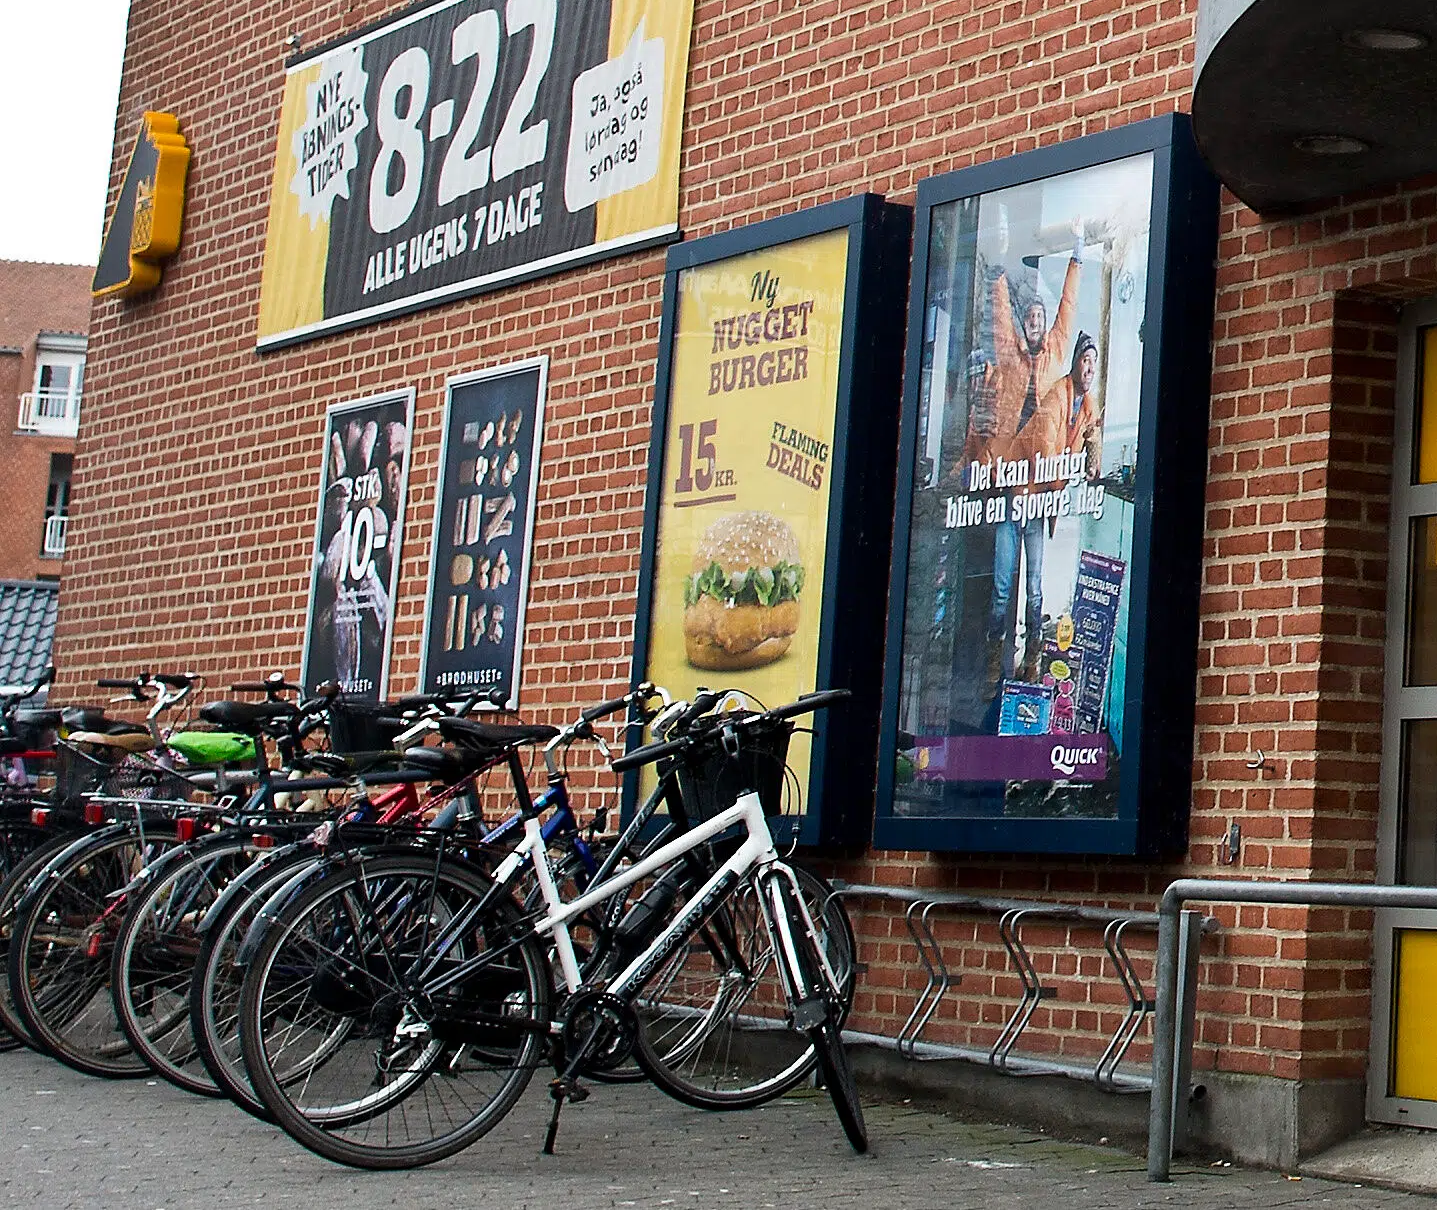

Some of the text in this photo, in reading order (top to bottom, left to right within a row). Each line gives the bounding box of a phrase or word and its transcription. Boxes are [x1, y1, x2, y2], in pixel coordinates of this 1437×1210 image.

[316, 71, 343, 118] NYE
[614, 62, 643, 104] også
[630, 96, 648, 121] og
[307, 142, 345, 197] TIDER
[363, 181, 544, 295] ALLE UGENS 7 DAGE
[750, 269, 780, 308] Ny
[711, 300, 814, 354] NUGGET
[708, 346, 809, 396] BURGER
[674, 419, 737, 493] 15 KR.
[771, 421, 829, 463] FLAMING
[766, 442, 825, 491] DEALS
[970, 446, 1088, 492] Det kan hurtigt
[945, 495, 983, 528] blive
[985, 495, 1006, 525] en
[1076, 481, 1105, 520] dag
[628, 931, 683, 991] KOGA
